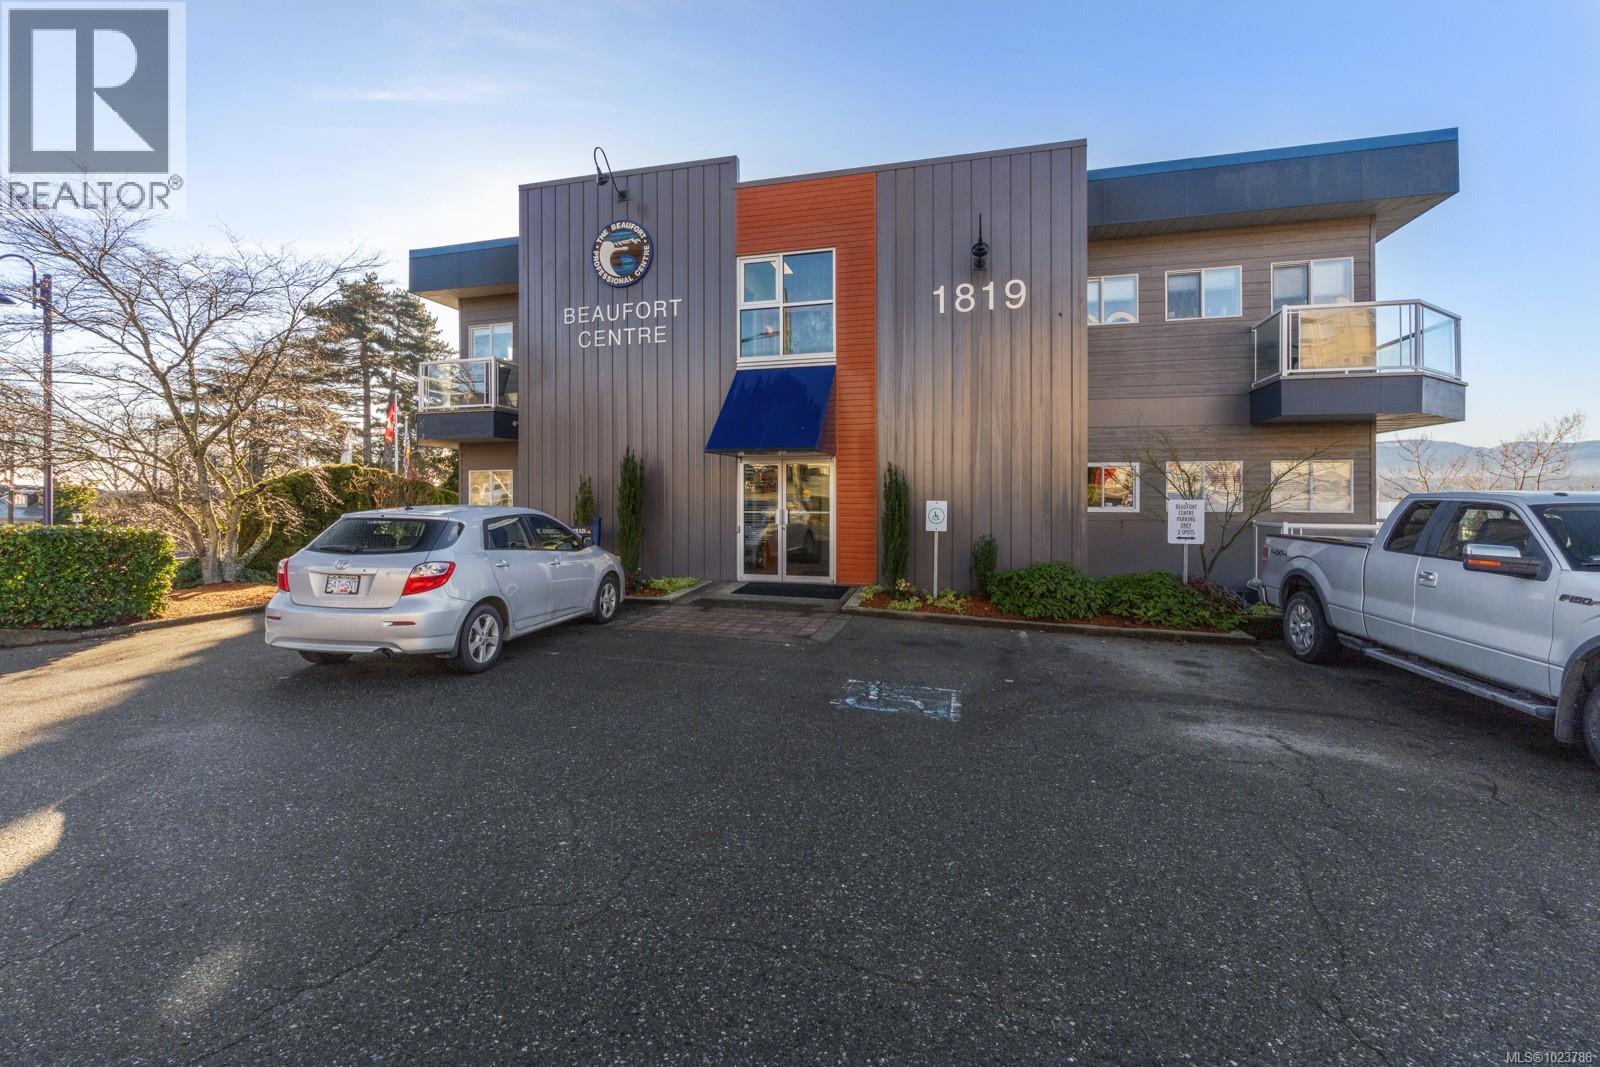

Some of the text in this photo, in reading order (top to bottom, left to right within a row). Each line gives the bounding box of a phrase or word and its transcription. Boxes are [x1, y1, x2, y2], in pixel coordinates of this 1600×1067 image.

[596, 221, 647, 244] THE BEAUFORT
[593, 245, 650, 285] PROFESSIONAL CENTRE
[932, 278, 1027, 314] 1819
[563, 298, 682, 325] BEAUFORT
[578, 325, 667, 348] CENTRE
